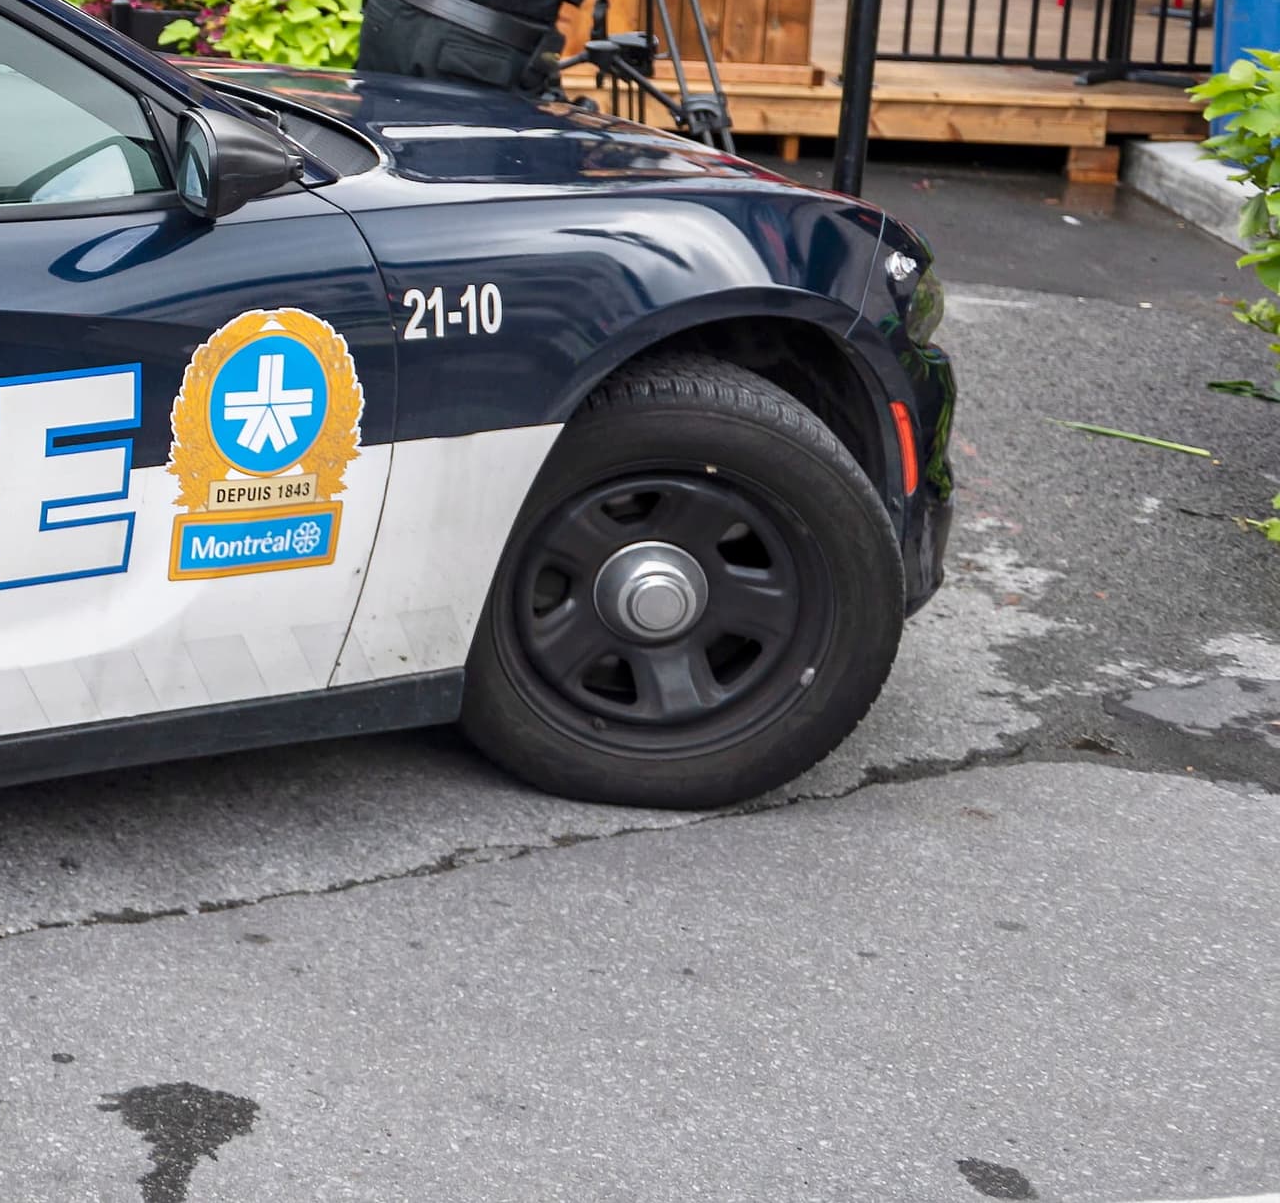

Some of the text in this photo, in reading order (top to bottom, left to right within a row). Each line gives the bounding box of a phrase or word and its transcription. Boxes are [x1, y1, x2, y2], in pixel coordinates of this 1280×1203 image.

[403, 282, 503, 341] 21-10
[216, 481, 311, 504] DEPUIS 1843
[190, 528, 291, 561] Montréal
